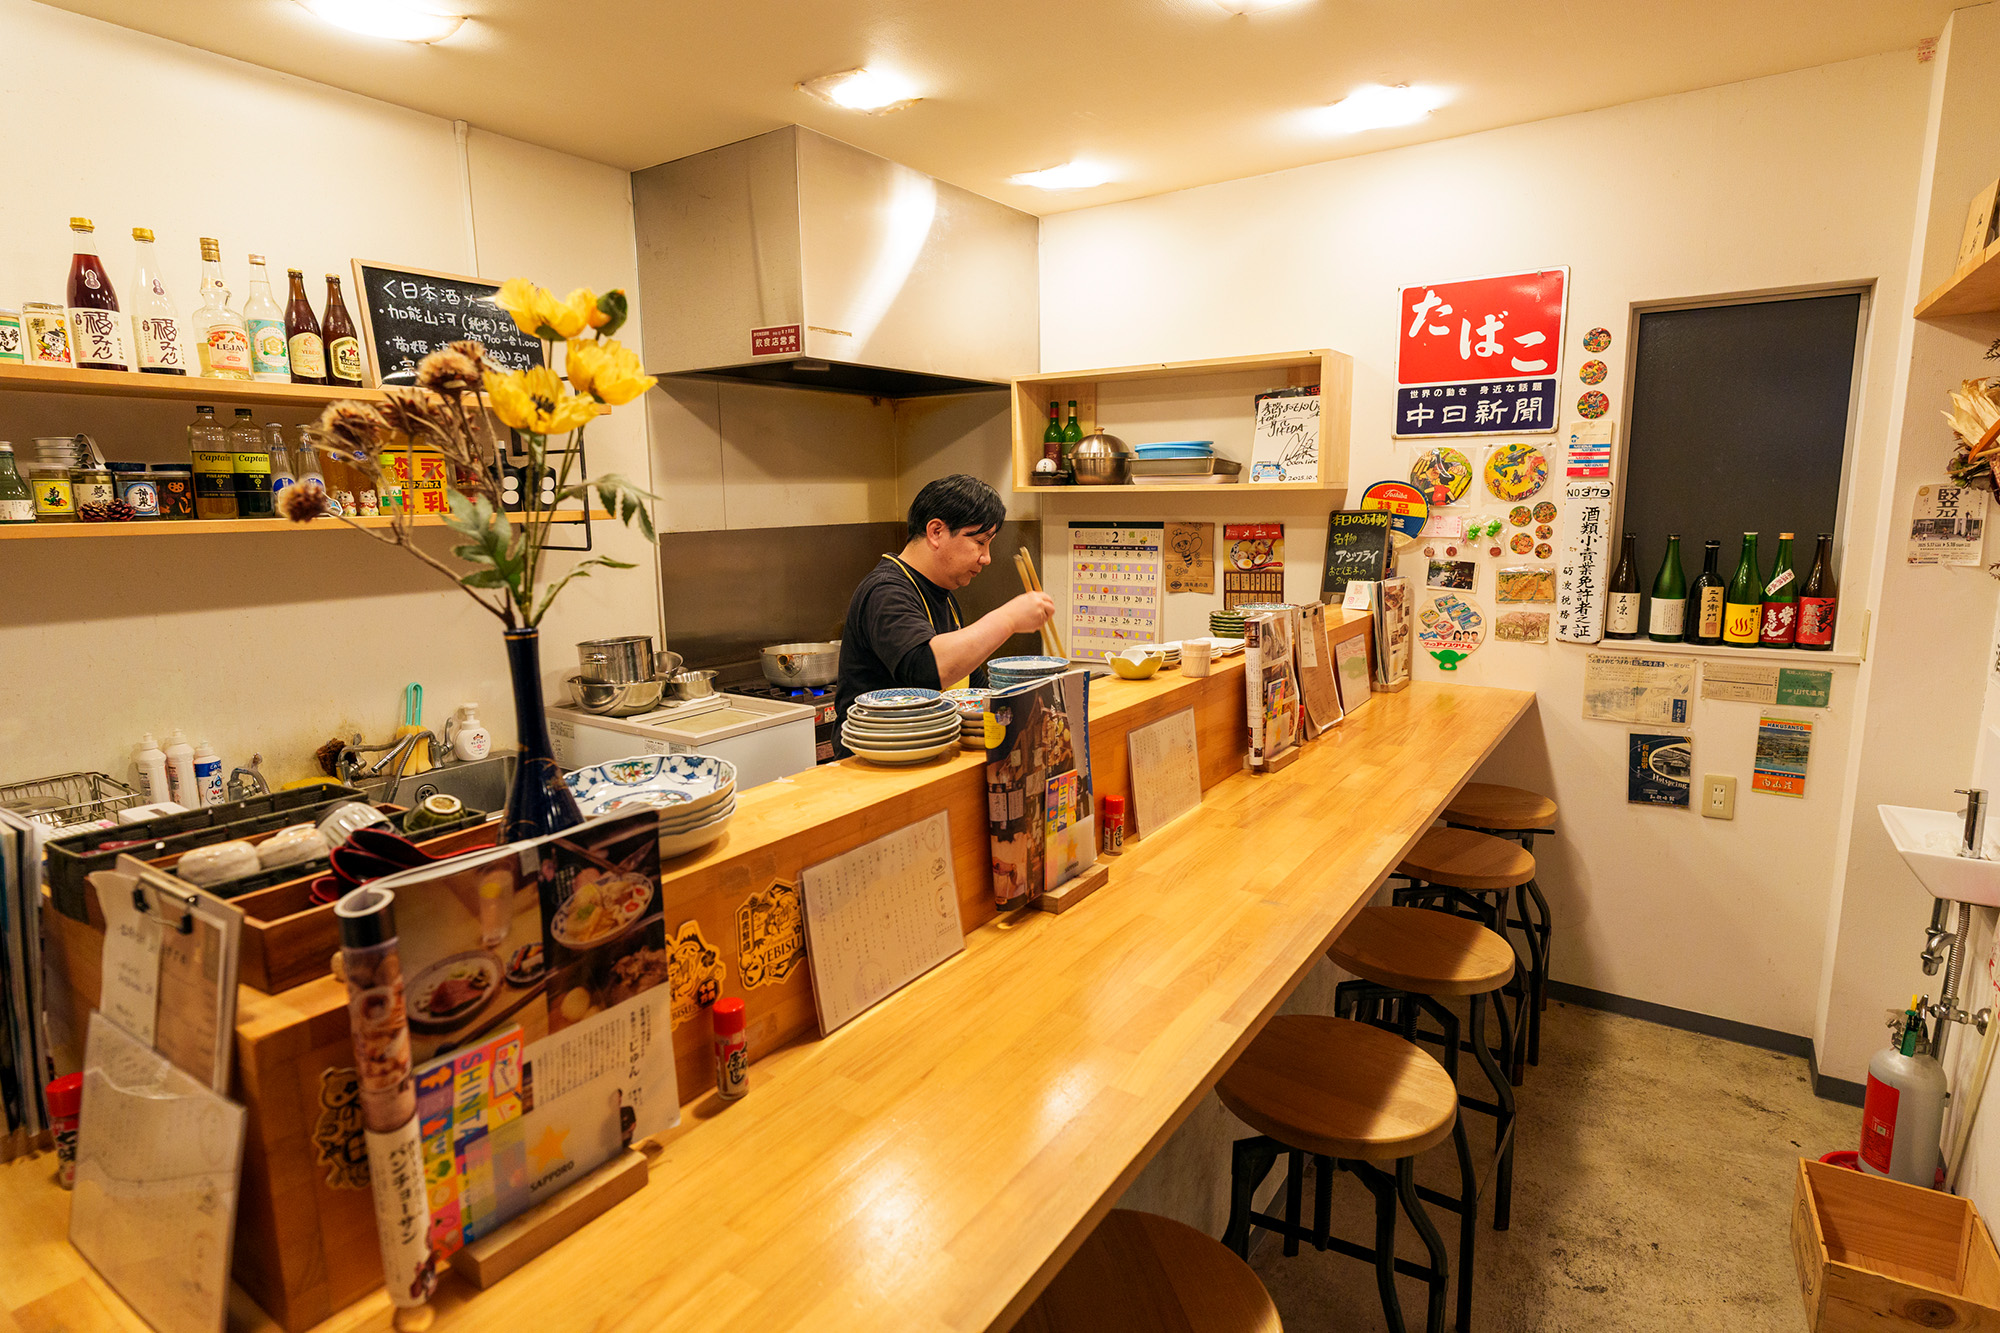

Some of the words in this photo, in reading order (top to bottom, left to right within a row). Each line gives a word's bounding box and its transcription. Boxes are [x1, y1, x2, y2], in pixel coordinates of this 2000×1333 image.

[83, 311, 114, 360] 福みりん
[1408, 289, 1549, 372] たばこ
[151, 318, 179, 365] 福みりん
[216, 343, 245, 352] LEJAY
[1409, 387, 1468, 399] 世界の動き
[1479, 382, 1543, 395] 身近な話題
[1406, 397, 1544, 428] 中日新聞
[199, 453, 231, 462] Captain
[238, 454, 268, 463] Captain
[1383, 488, 1408, 500] Toshiba
[1377, 500, 1410, 515] 特品
[1936, 508, 1958, 518] フェス
[1331, 513, 1388, 528] 本日のおすすめ
[1111, 531, 1120, 543] 2
[1243, 529, 1279, 538] メニュー
[1333, 532, 1358, 546] 名物
[1335, 549, 1380, 565] アジフライ
[1767, 722, 1805, 731] HAKUSANSO
[1652, 773, 1688, 790] Hotspring
[759, 934, 802, 965] YEBISU
[529, 1160, 576, 1194] SAPPORO
